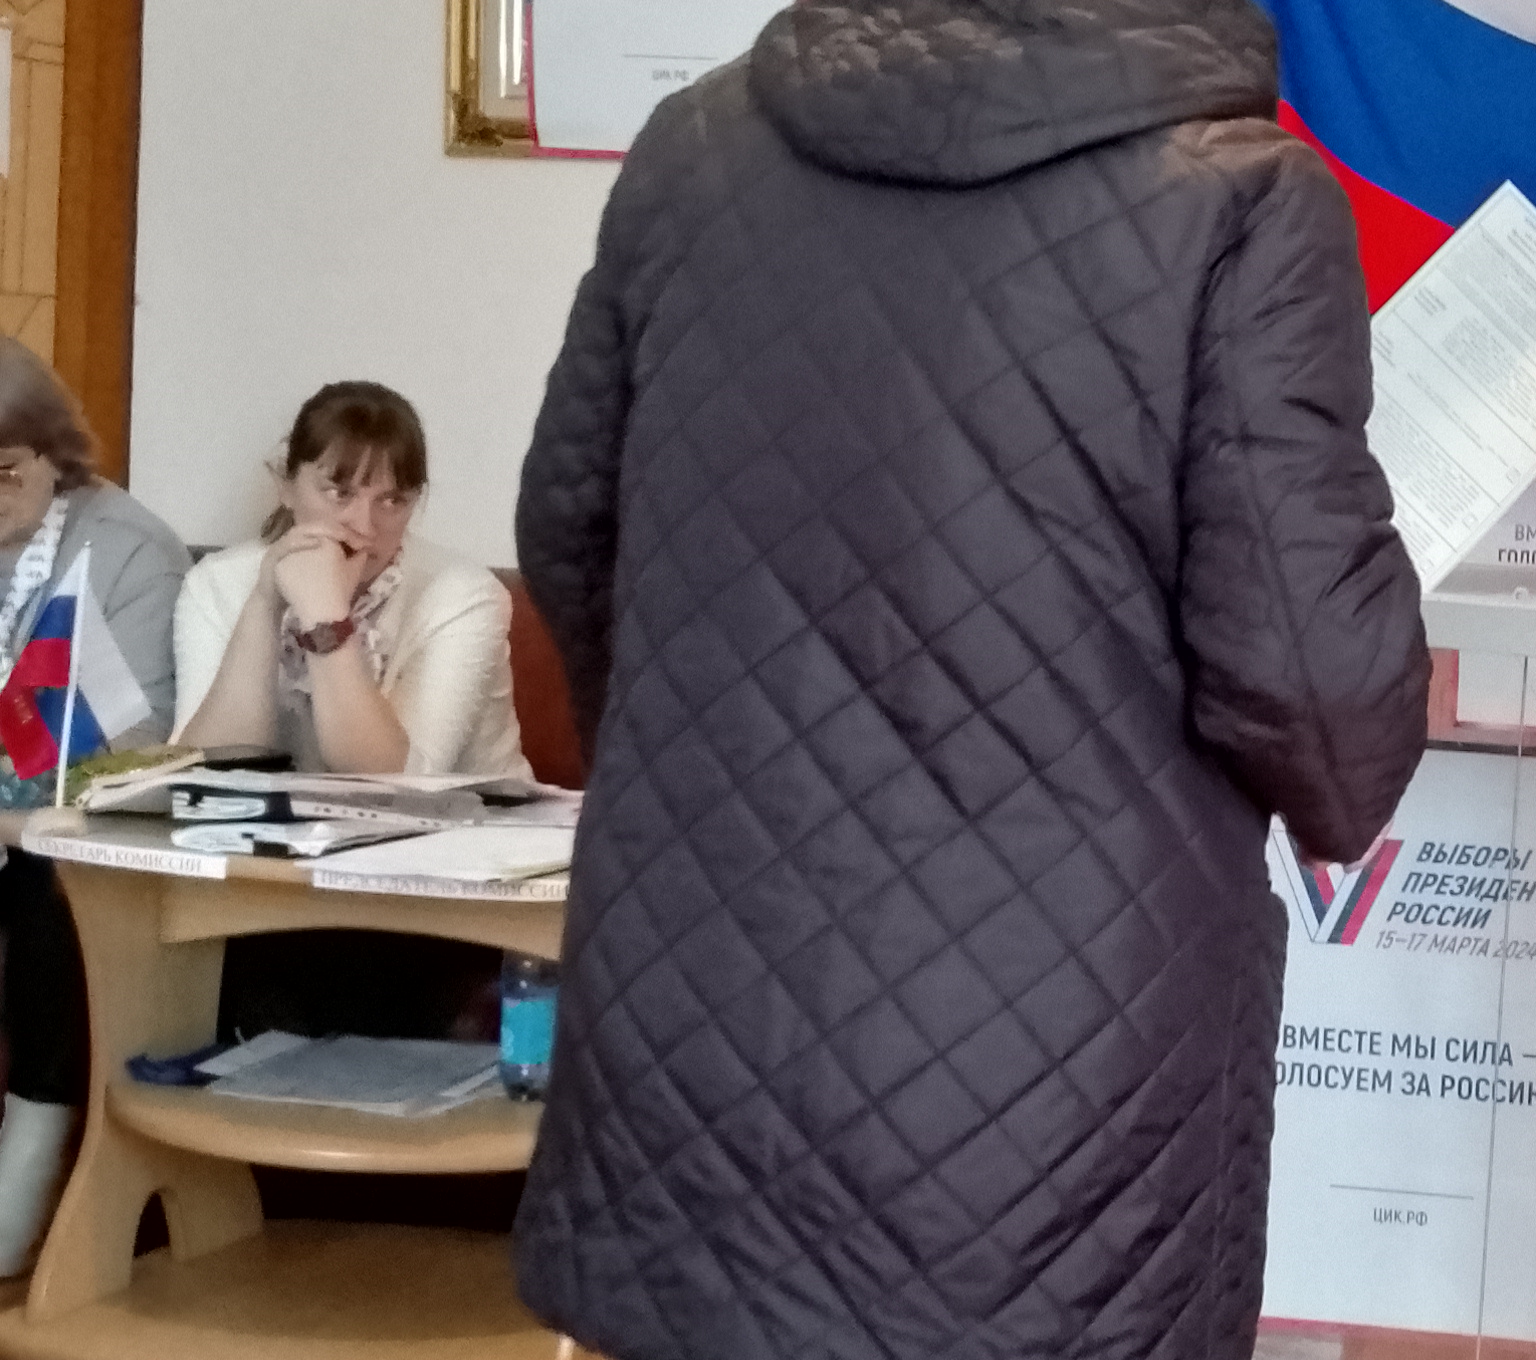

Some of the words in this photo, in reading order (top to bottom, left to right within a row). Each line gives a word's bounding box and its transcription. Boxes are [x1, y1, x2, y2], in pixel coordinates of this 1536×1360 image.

[1416, 841, 1533, 871] ВЫБОРЫ
[1386, 901, 1493, 930] РОССИИ
[1374, 929, 1425, 954] 15–17
[1427, 934, 1489, 958] МАРТА
[1282, 1024, 1384, 1057] ВМЕСТЕ
[1390, 1032, 1437, 1061] МЫ
[1445, 1037, 1514, 1067] СИЛА
[1275, 1061, 1393, 1095] ОЛОСУЕМ
[1401, 1070, 1432, 1099] ЗА
